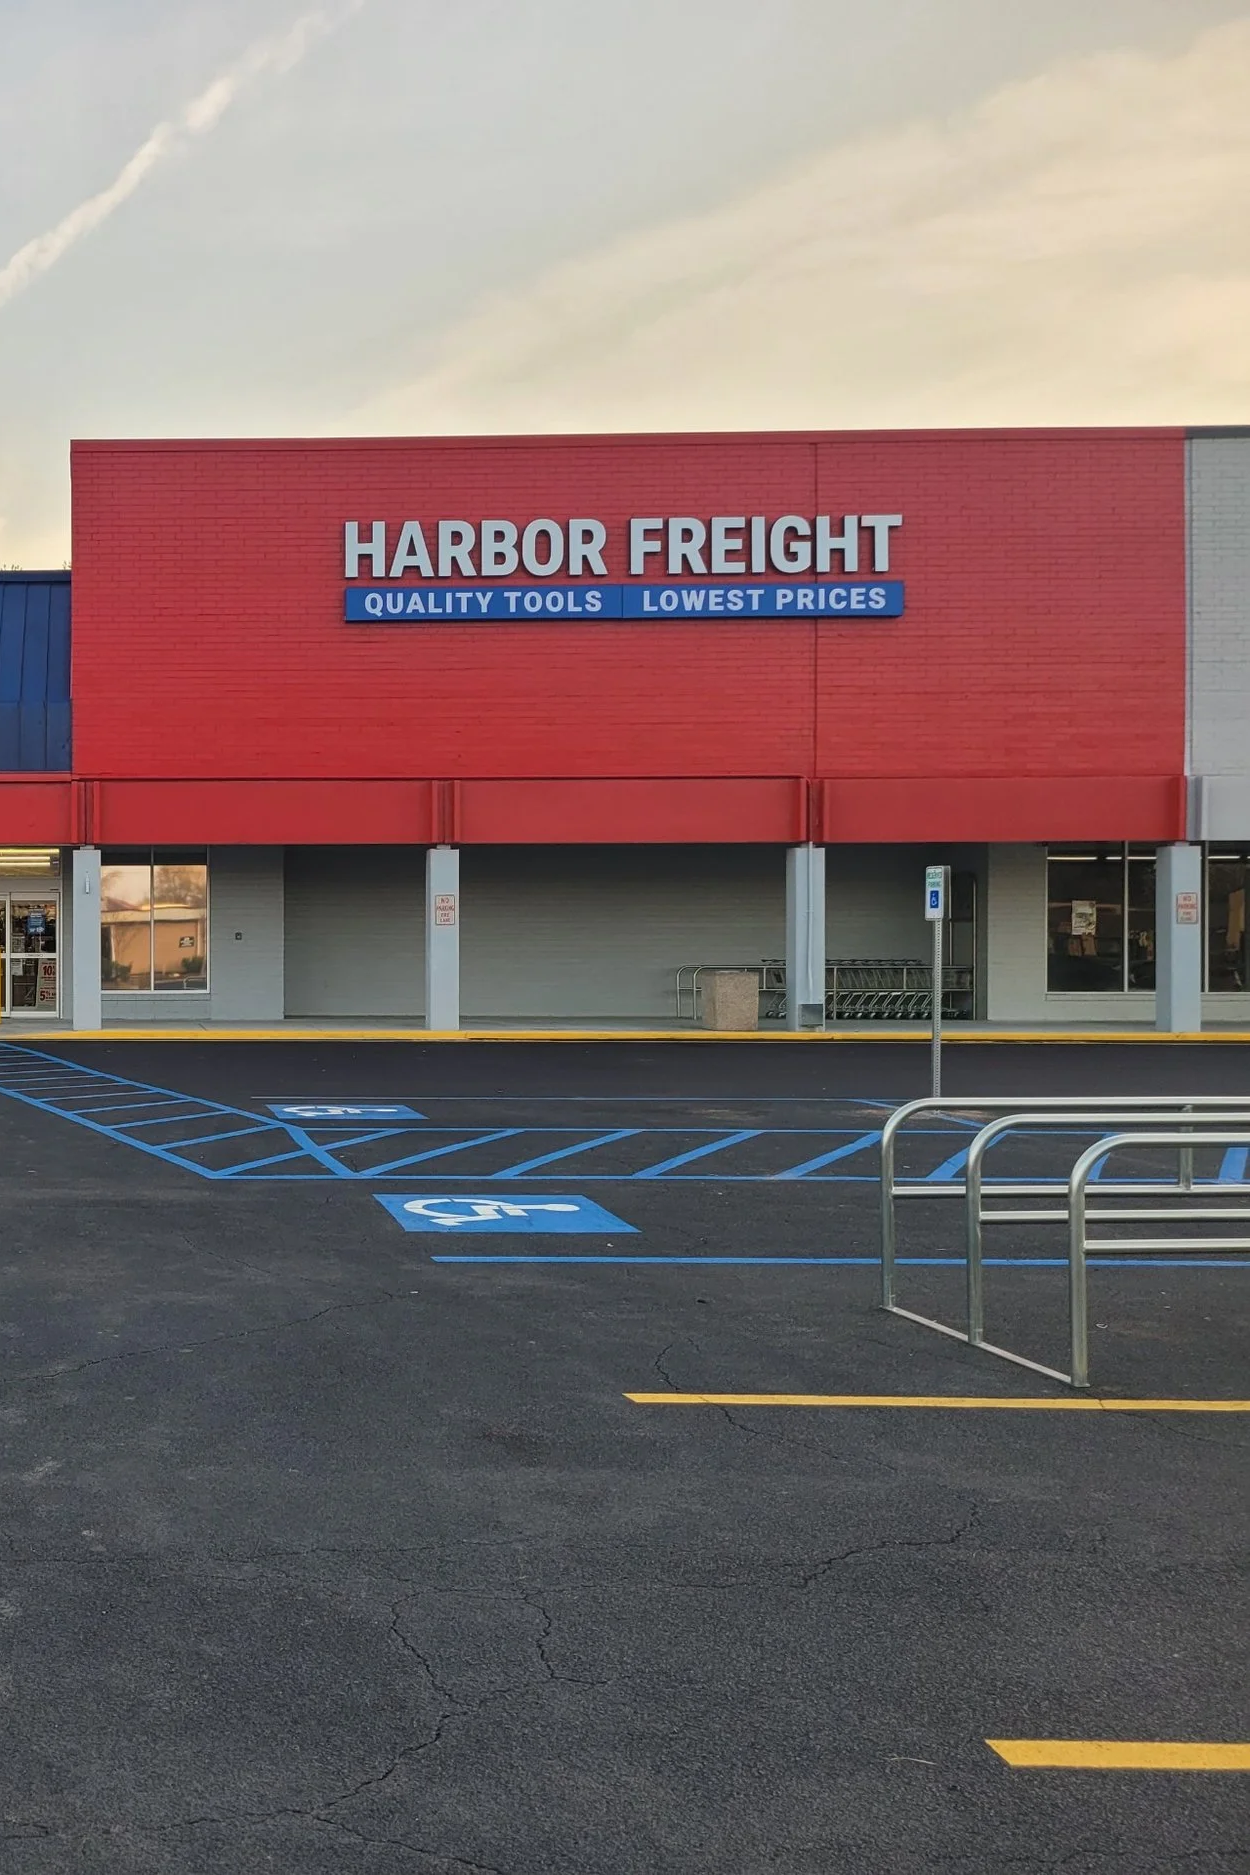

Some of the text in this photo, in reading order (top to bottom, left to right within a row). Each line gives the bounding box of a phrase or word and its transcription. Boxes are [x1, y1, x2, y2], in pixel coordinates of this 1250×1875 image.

[344, 514, 903, 578] HARBOR FREIGHT
[364, 587, 887, 617] QUALITY TOOLS LOWEST PRICES
